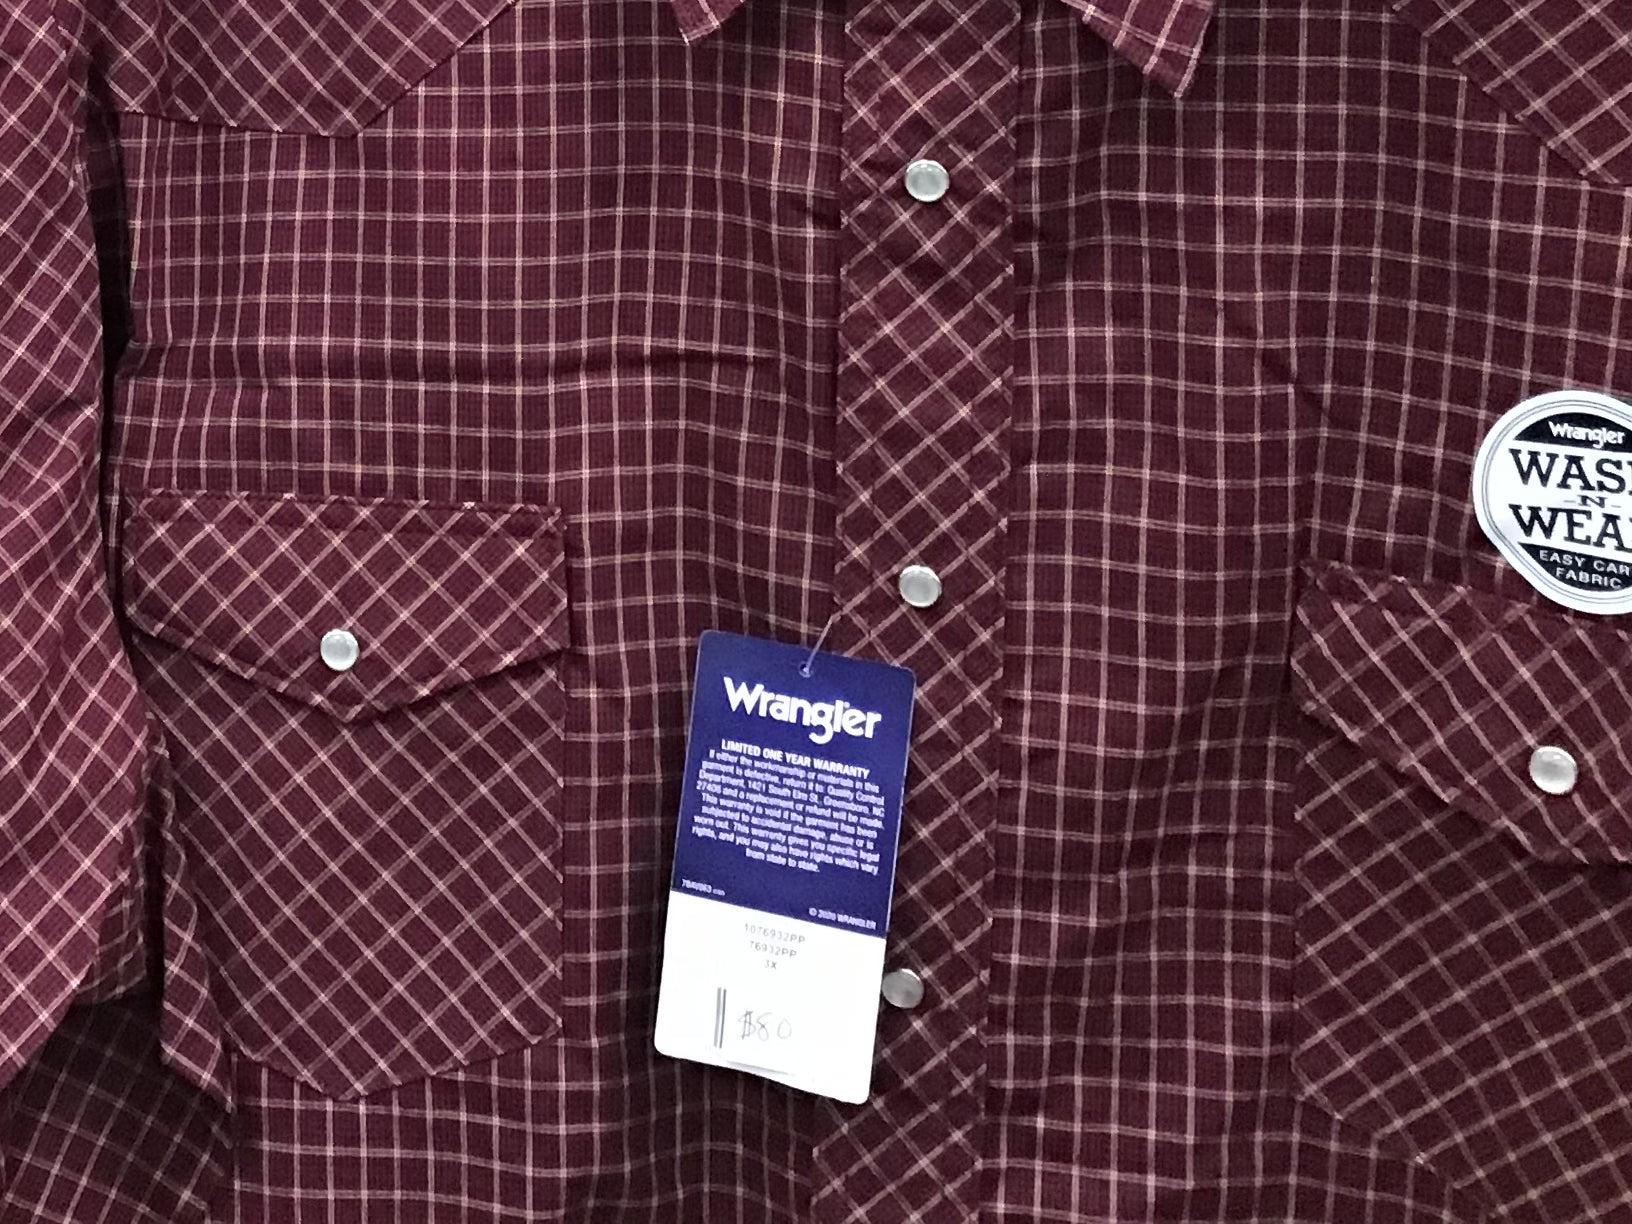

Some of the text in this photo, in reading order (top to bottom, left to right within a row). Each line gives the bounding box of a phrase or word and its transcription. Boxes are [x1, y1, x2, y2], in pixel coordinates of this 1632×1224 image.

[1548, 421, 1626, 448] Wrangler
[1508, 448, 1632, 495] WAS
[1508, 503, 1632, 553] WEA
[1539, 549, 1631, 576] EASY CAR
[1555, 567, 1622, 589] FABRIC
[723, 676, 882, 744] Wrangler
[721, 738, 870, 779] LIMITED ONE YEAR WARRANTY
